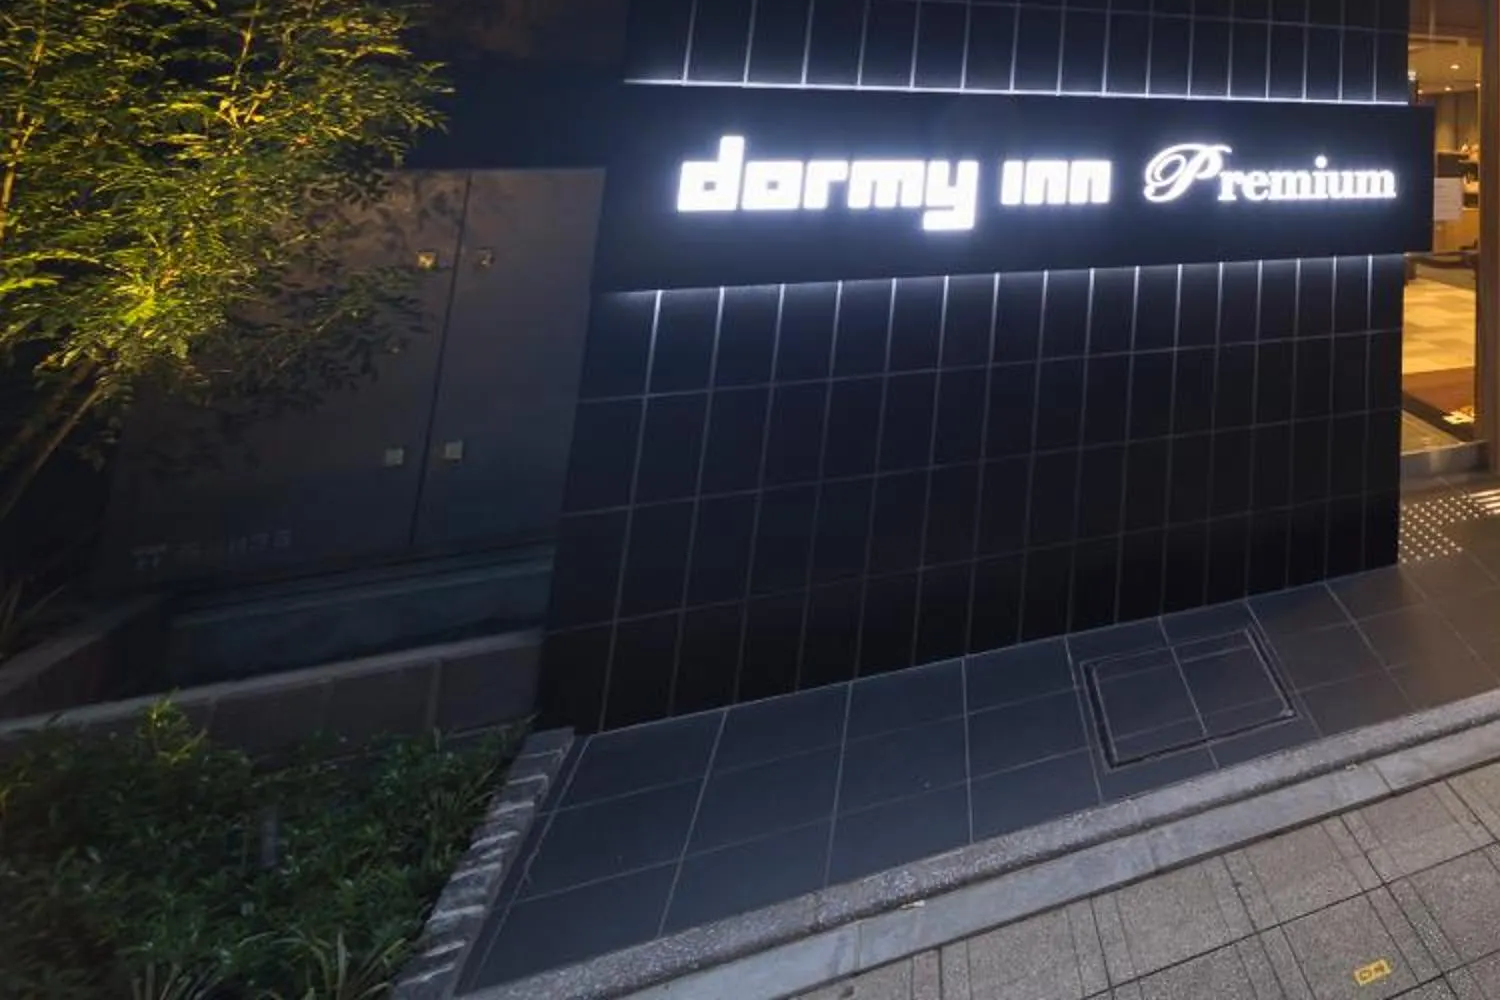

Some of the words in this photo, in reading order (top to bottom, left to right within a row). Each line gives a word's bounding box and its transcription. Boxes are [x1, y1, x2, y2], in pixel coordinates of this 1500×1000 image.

[677, 135, 979, 231] dormy
[1001, 160, 1111, 206] inn
[1143, 143, 1396, 201] Premium
